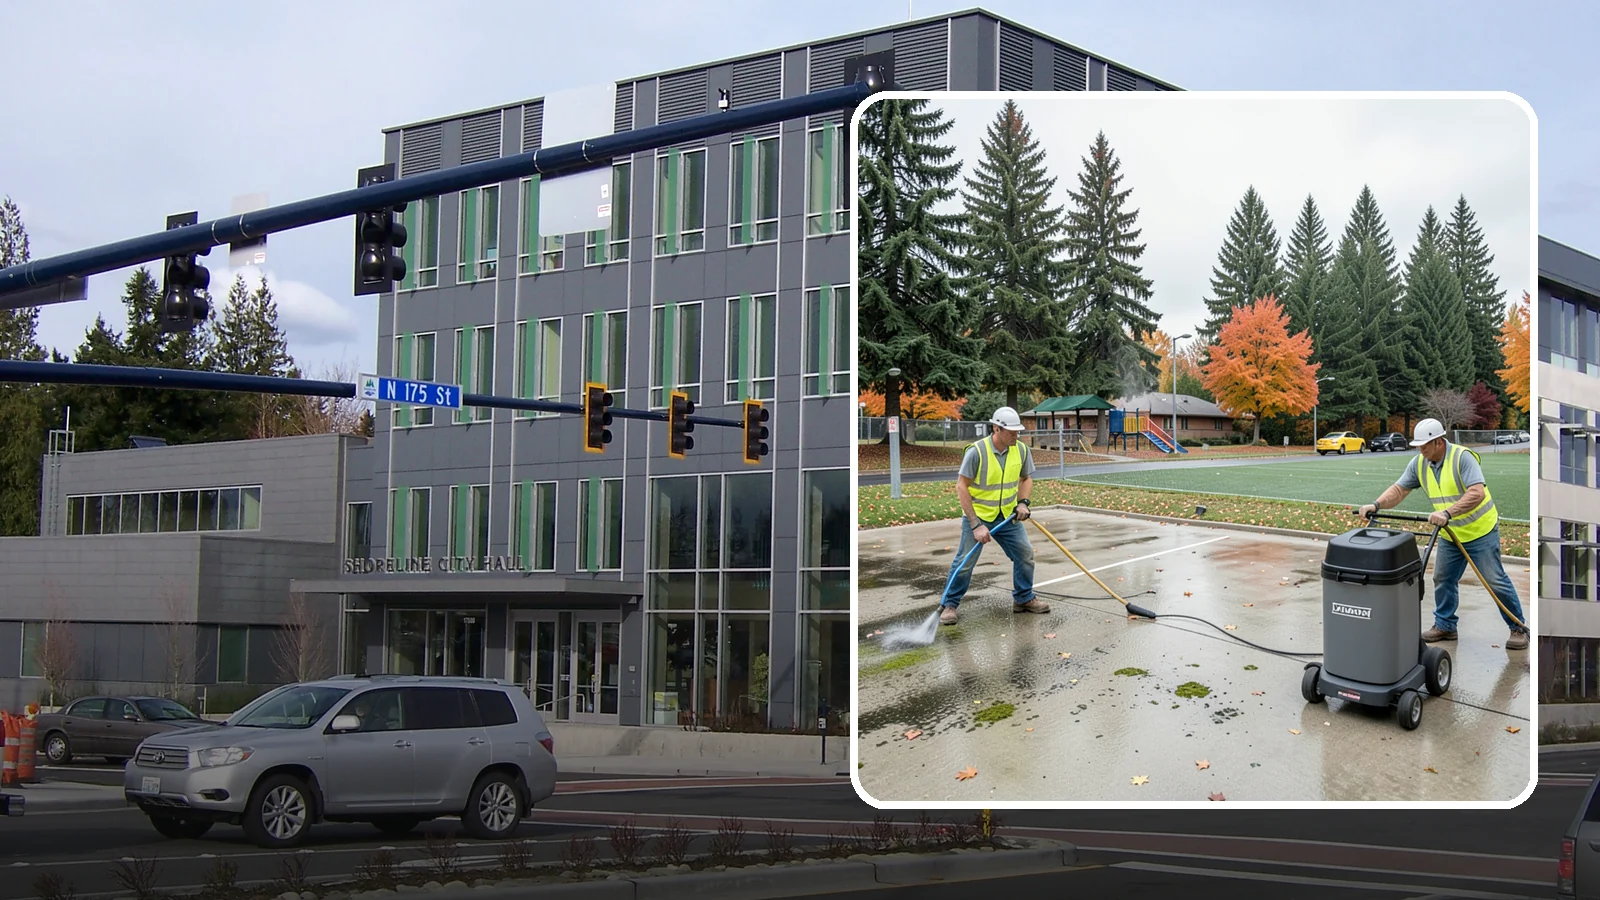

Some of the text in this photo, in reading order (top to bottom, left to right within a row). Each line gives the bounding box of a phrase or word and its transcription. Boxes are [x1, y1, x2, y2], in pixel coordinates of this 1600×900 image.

[387, 380, 451, 406] N 175 St
[343, 555, 525, 574] SHORELINE CITY HALL
